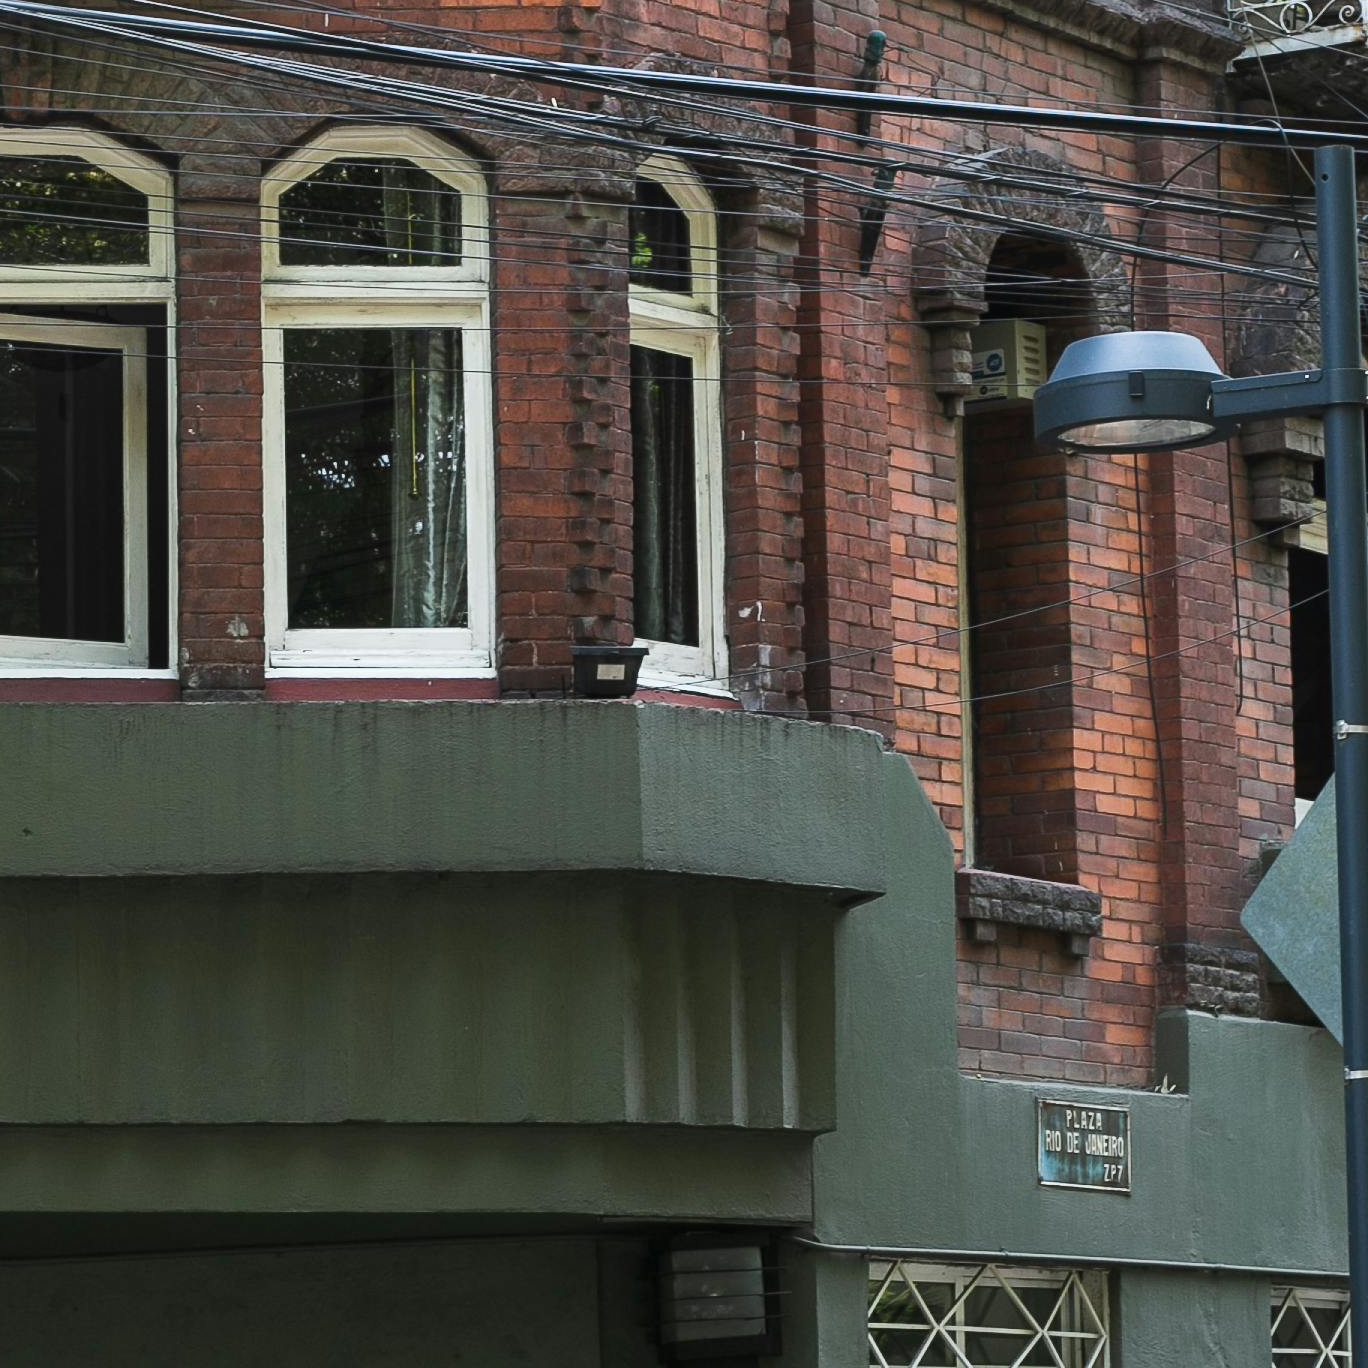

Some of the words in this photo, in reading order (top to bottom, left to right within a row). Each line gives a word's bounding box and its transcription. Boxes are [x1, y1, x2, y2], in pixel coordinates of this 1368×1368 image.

[1066, 1110, 1102, 1130] PLAZA
[1045, 1130, 1061, 1151] RIO
[1067, 1132, 1080, 1153] DE
[1085, 1134, 1124, 1157] JANEIRO
